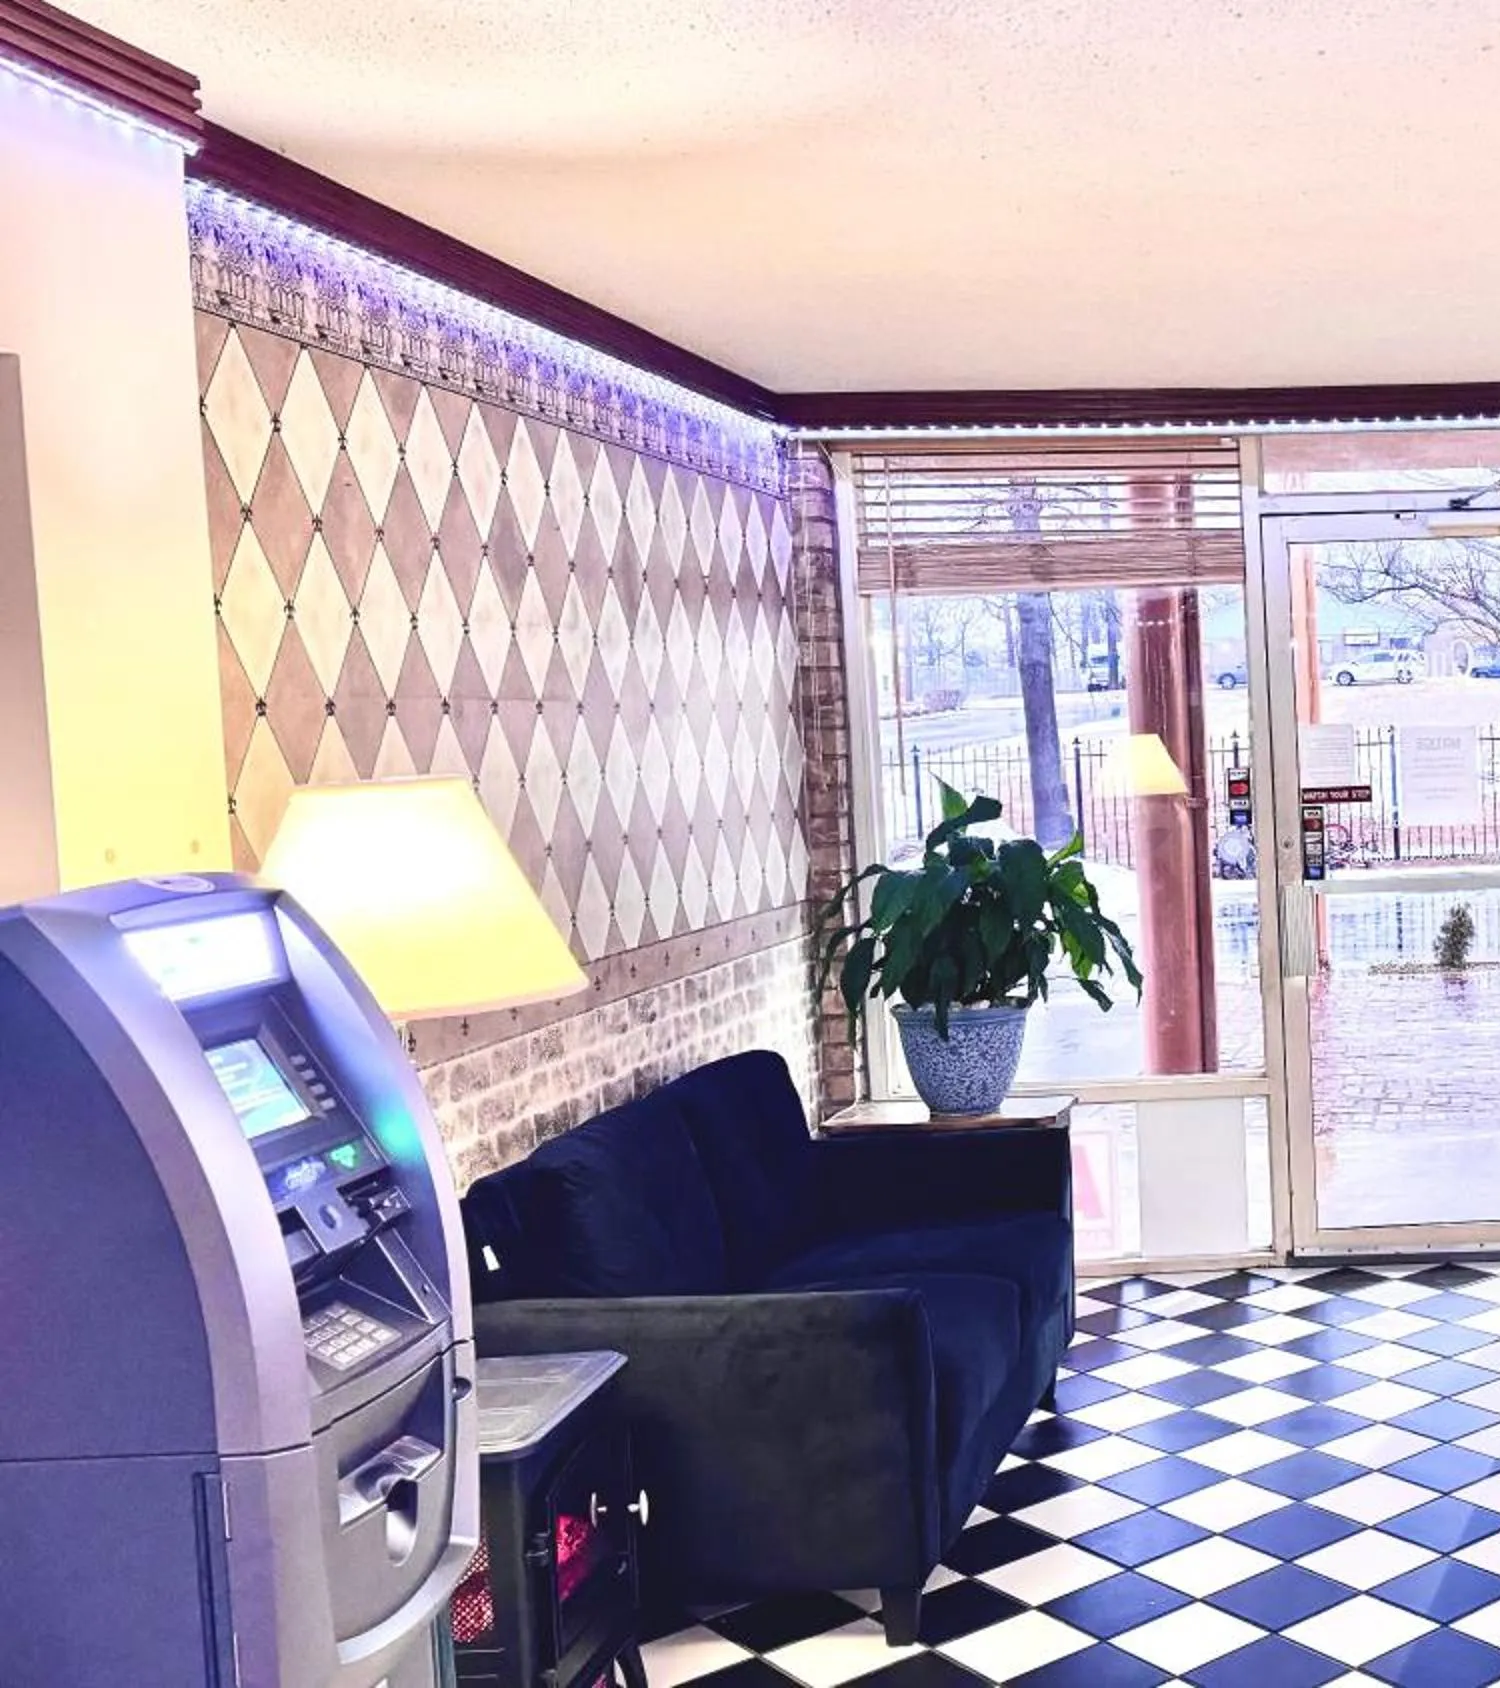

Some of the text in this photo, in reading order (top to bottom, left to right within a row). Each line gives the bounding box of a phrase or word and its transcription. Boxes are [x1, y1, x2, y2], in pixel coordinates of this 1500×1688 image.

[1303, 789, 1370, 800] WATCH YOUR STEP
